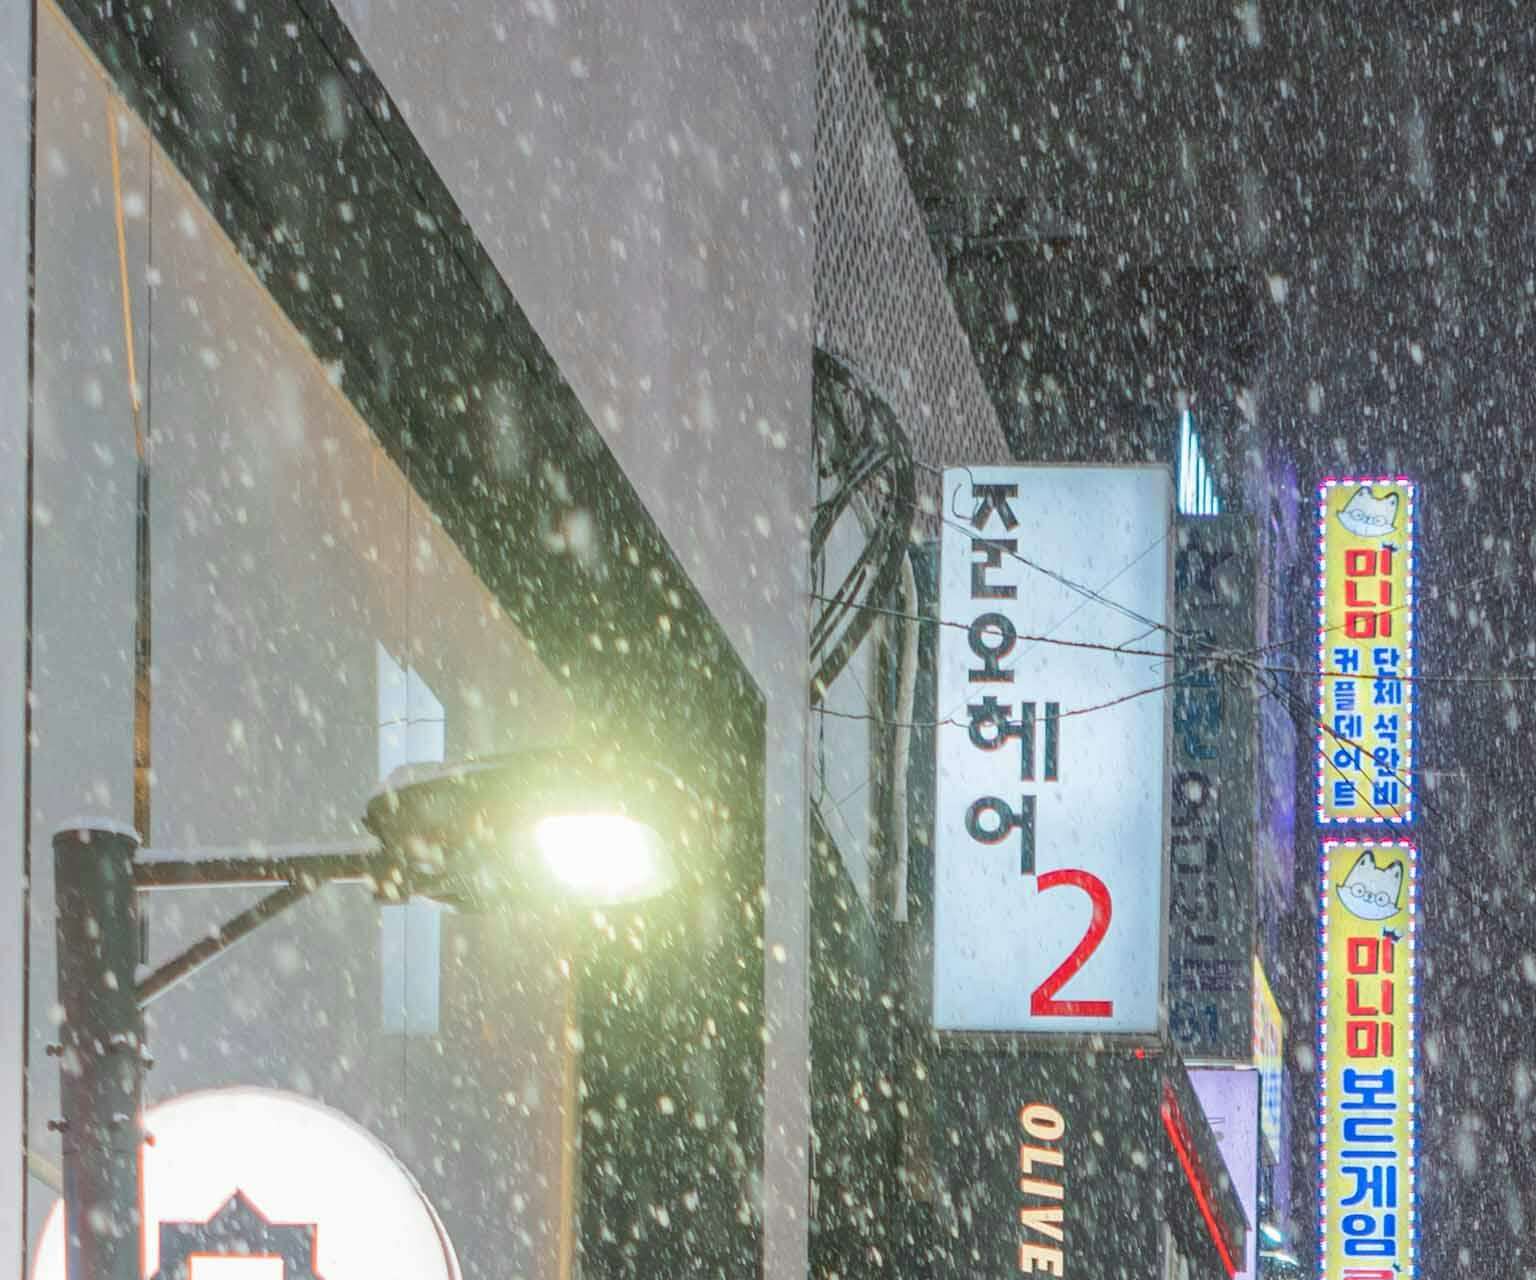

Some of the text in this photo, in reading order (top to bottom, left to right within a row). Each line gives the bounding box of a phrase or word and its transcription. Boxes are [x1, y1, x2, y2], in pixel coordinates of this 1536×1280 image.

[1344, 548, 1393, 639] 미니미
[1030, 868, 1114, 1018] 2
[1347, 937, 1394, 1058] 미니미
[1019, 1103, 1064, 1278] OLIVE
